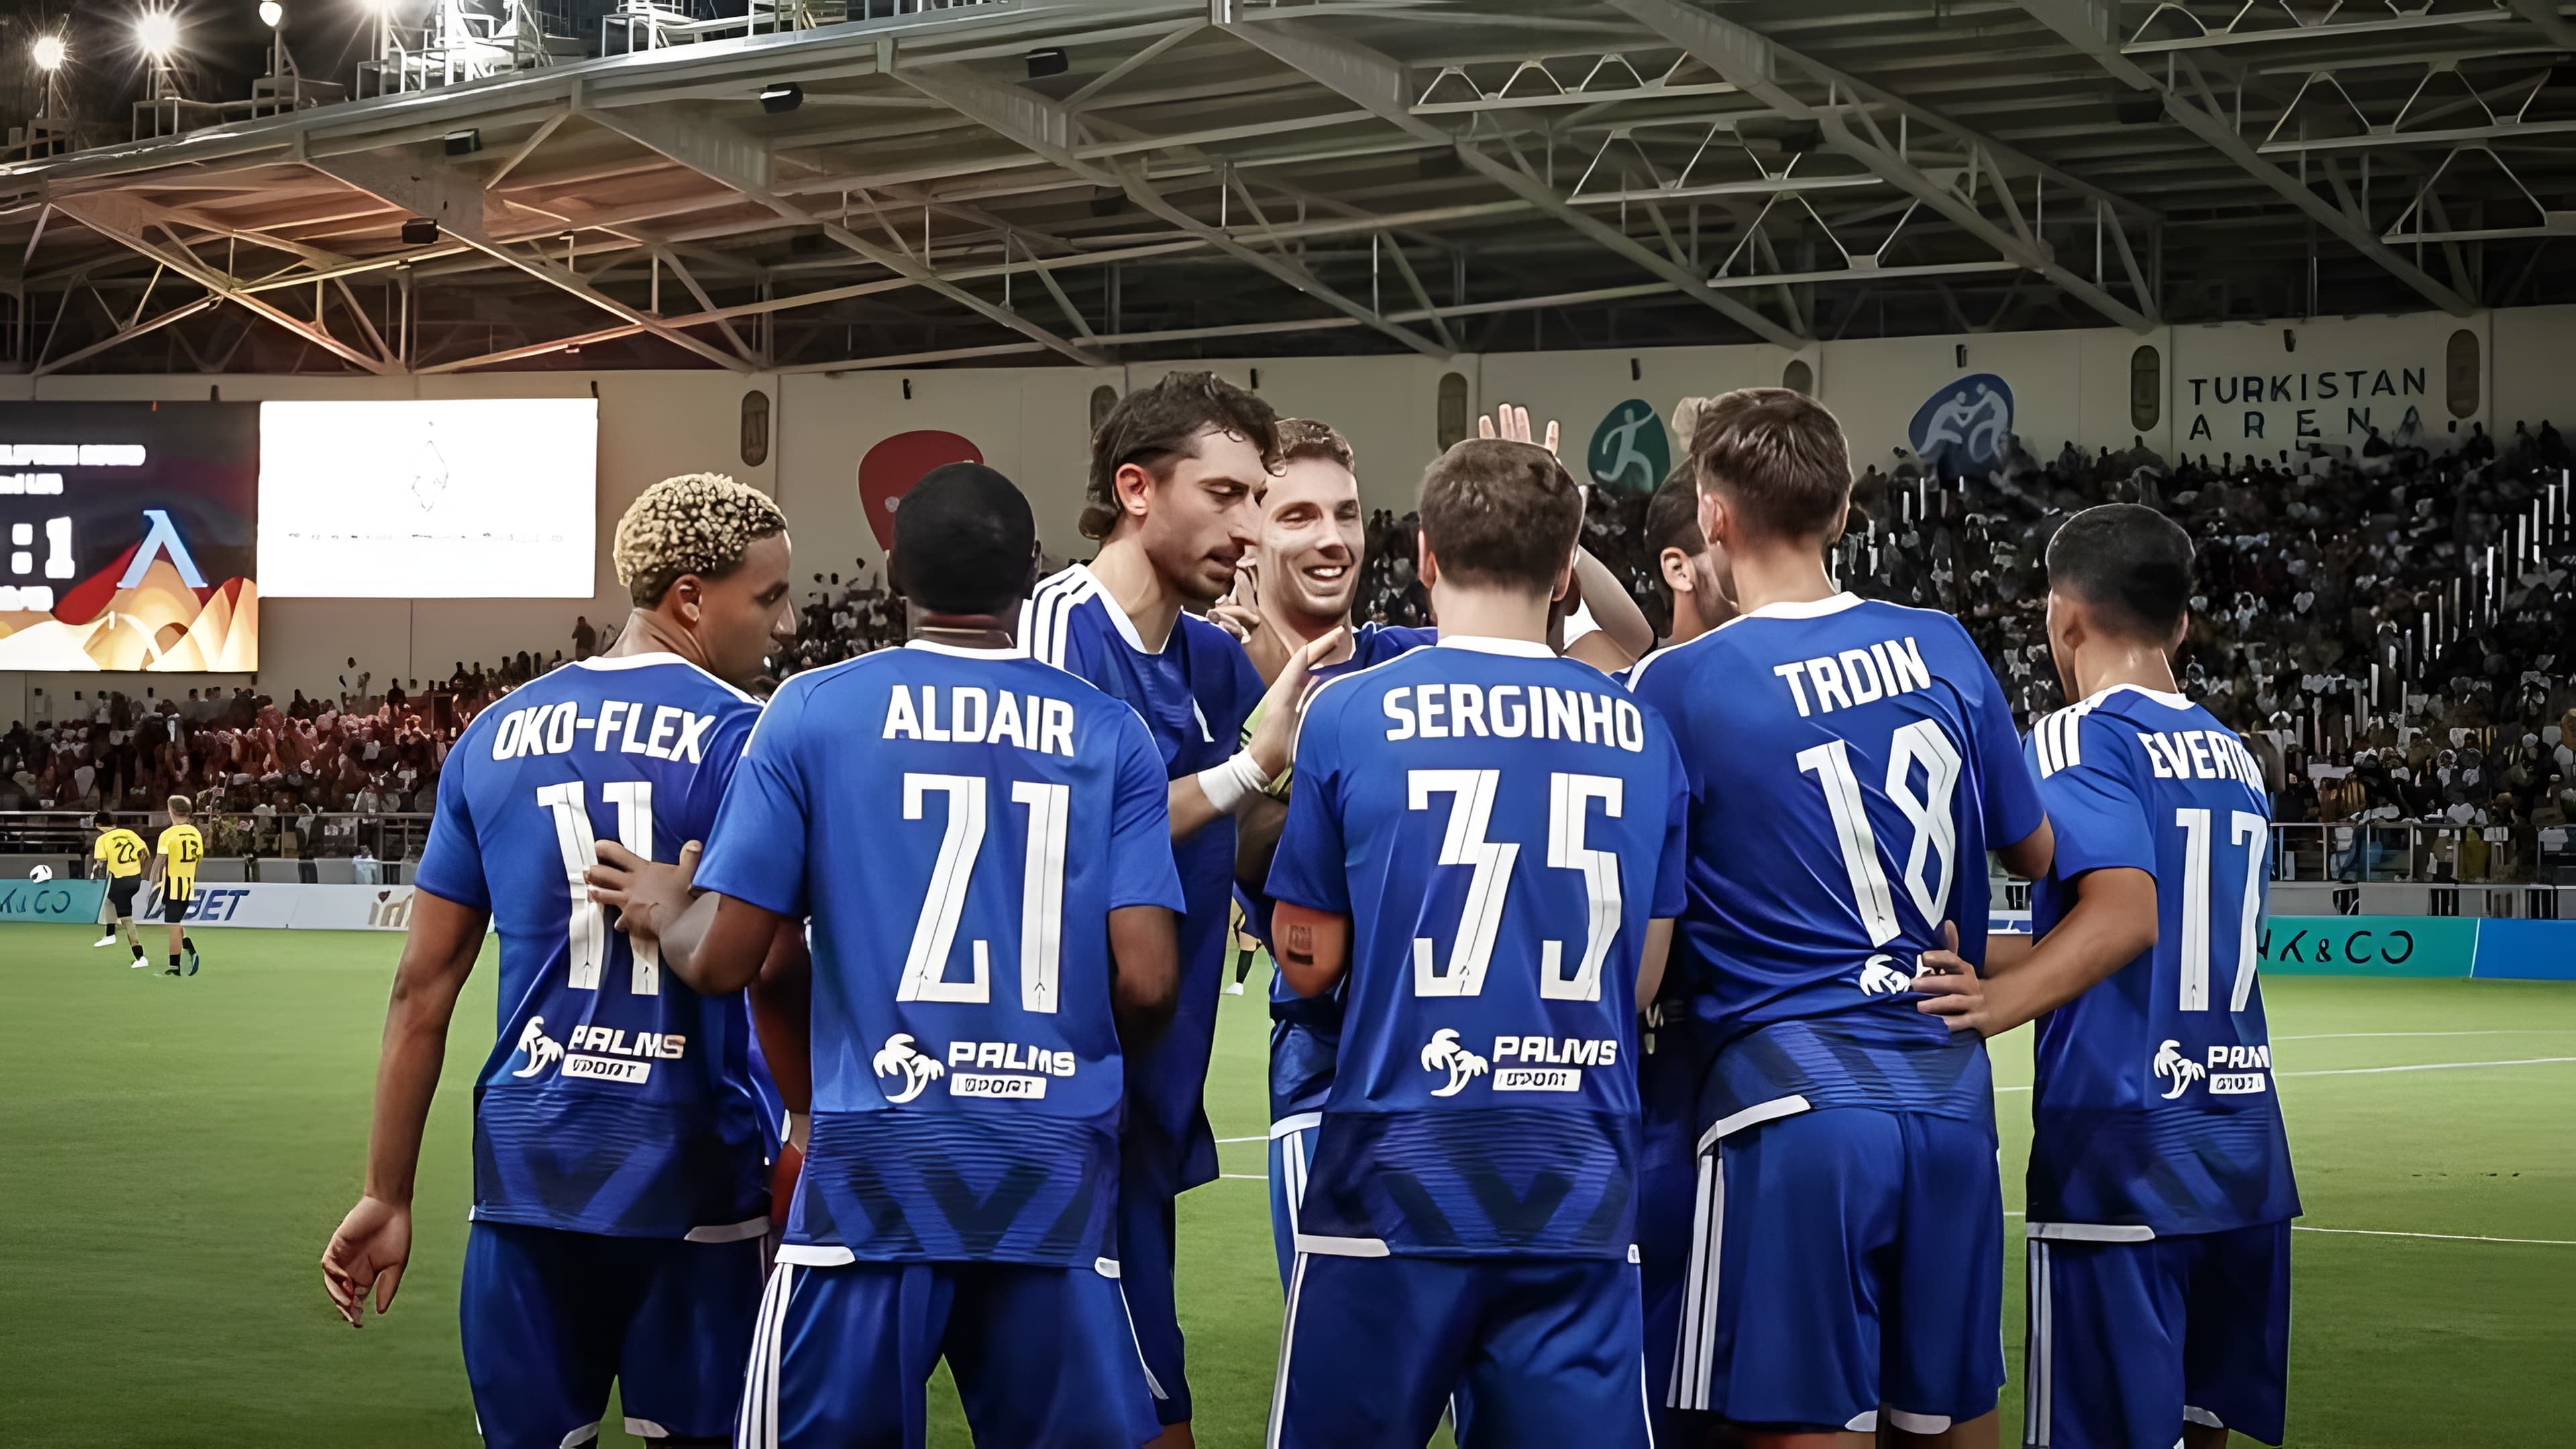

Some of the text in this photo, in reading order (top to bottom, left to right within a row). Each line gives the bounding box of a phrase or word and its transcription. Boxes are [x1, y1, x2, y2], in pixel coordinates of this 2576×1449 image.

[2188, 367, 2426, 406] TURKISTAN
[2188, 405, 2424, 448] ARENA
[1773, 636, 1931, 717] TRDIN
[492, 700, 716, 764] OKO-FLEX
[881, 684, 1075, 757] ALDAIR
[1382, 683, 1644, 753] SERGINHO
[1795, 718, 1963, 949] 18
[537, 781, 659, 996] 11
[896, 772, 1070, 1014] 21
[1407, 769, 1623, 1002] 35
[2175, 808, 2268, 1012] 17
[567, 1024, 686, 1059] PALMS
[948, 1040, 1076, 1077] PALMS
[1493, 1036, 1618, 1066] PALMS
